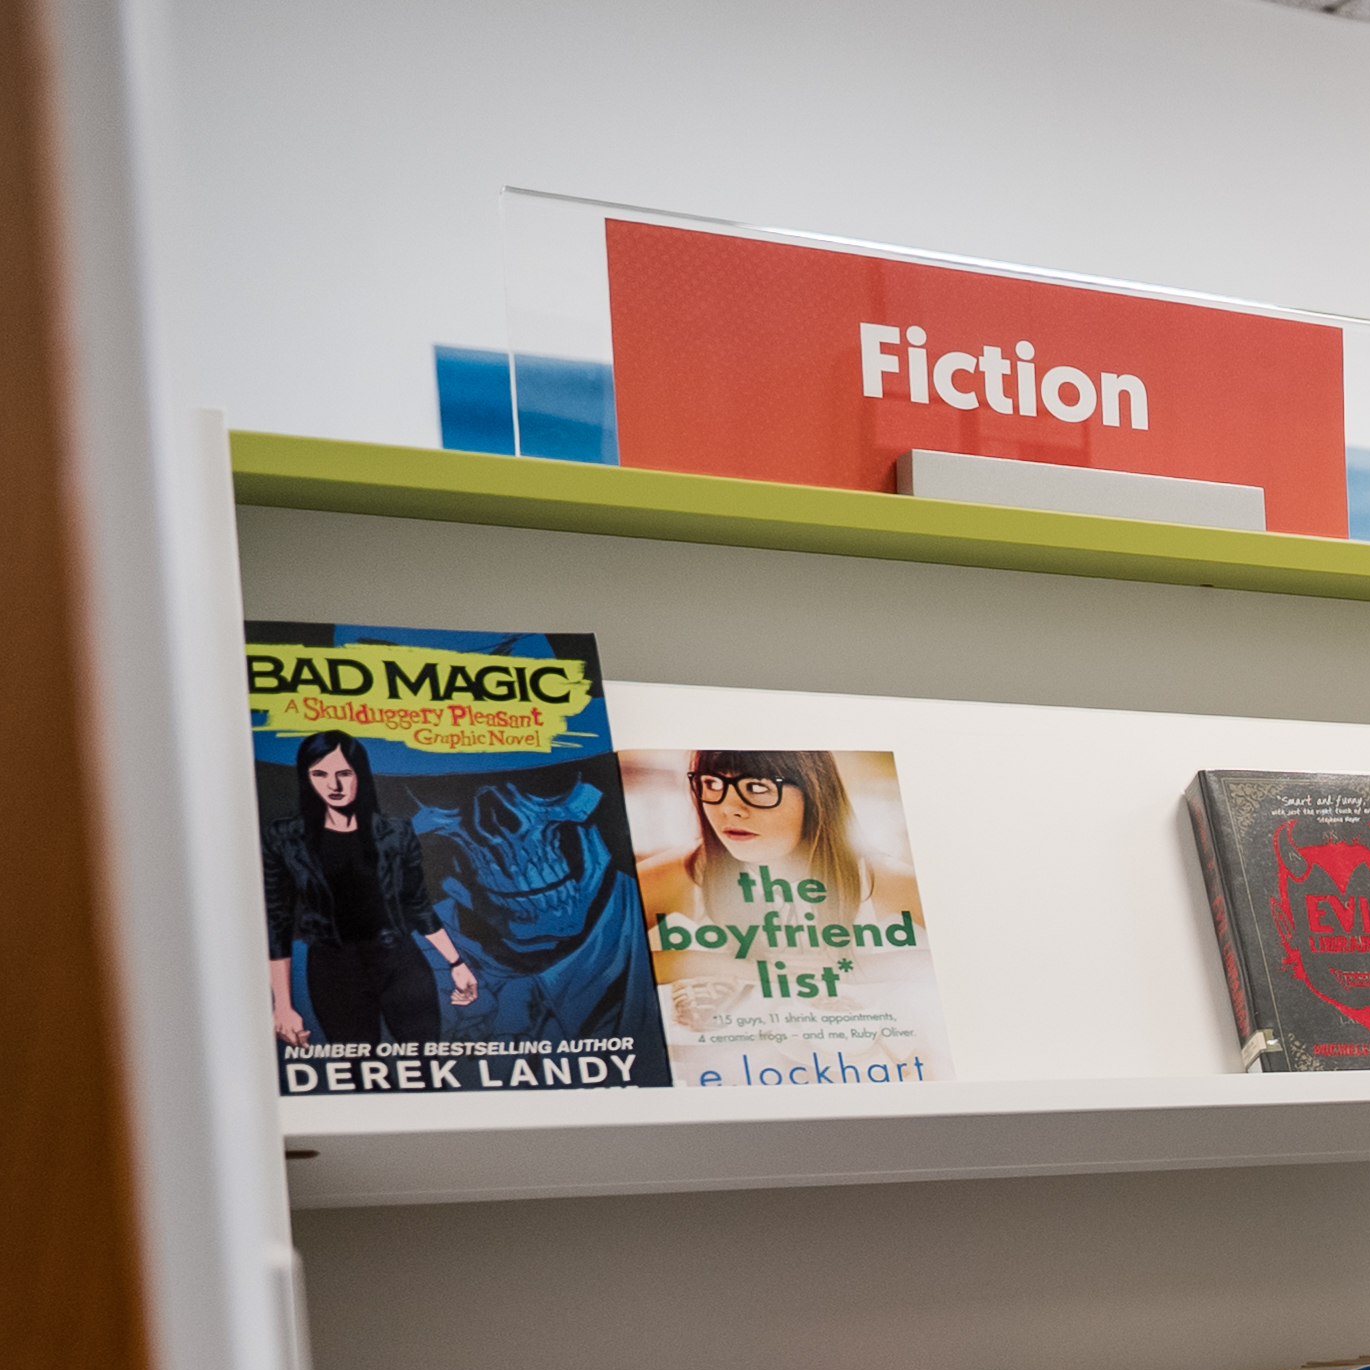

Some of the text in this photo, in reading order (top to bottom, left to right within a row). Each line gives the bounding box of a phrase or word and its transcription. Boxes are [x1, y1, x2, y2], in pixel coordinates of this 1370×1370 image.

[860, 320, 1149, 432] Fiction
[249, 656, 571, 703] BAD MAGIC
[285, 697, 543, 730] A Skulduggery Pleasant
[414, 728, 541, 748] Graphic Novel
[738, 866, 827, 904] the
[656, 911, 917, 963] boyfriend
[710, 1032, 754, 1043] ceramic
[759, 1031, 787, 1043] frogs
[803, 1030, 824, 1039] and
[829, 1032, 848, 1040] me,
[851, 1029, 877, 1040] Ruby
[882, 1027, 916, 1037] Oliver.
[737, 1016, 765, 1027] guys,
[769, 1014, 780, 1023] 11
[785, 1013, 817, 1023] shrink
[821, 1013, 897, 1024] appointments,
[285, 1037, 634, 1059] NUMBER ONE BESTSELLING AUTHOR
[286, 1054, 636, 1092] DEREK LANDY
[743, 1052, 923, 1086] lockhart
